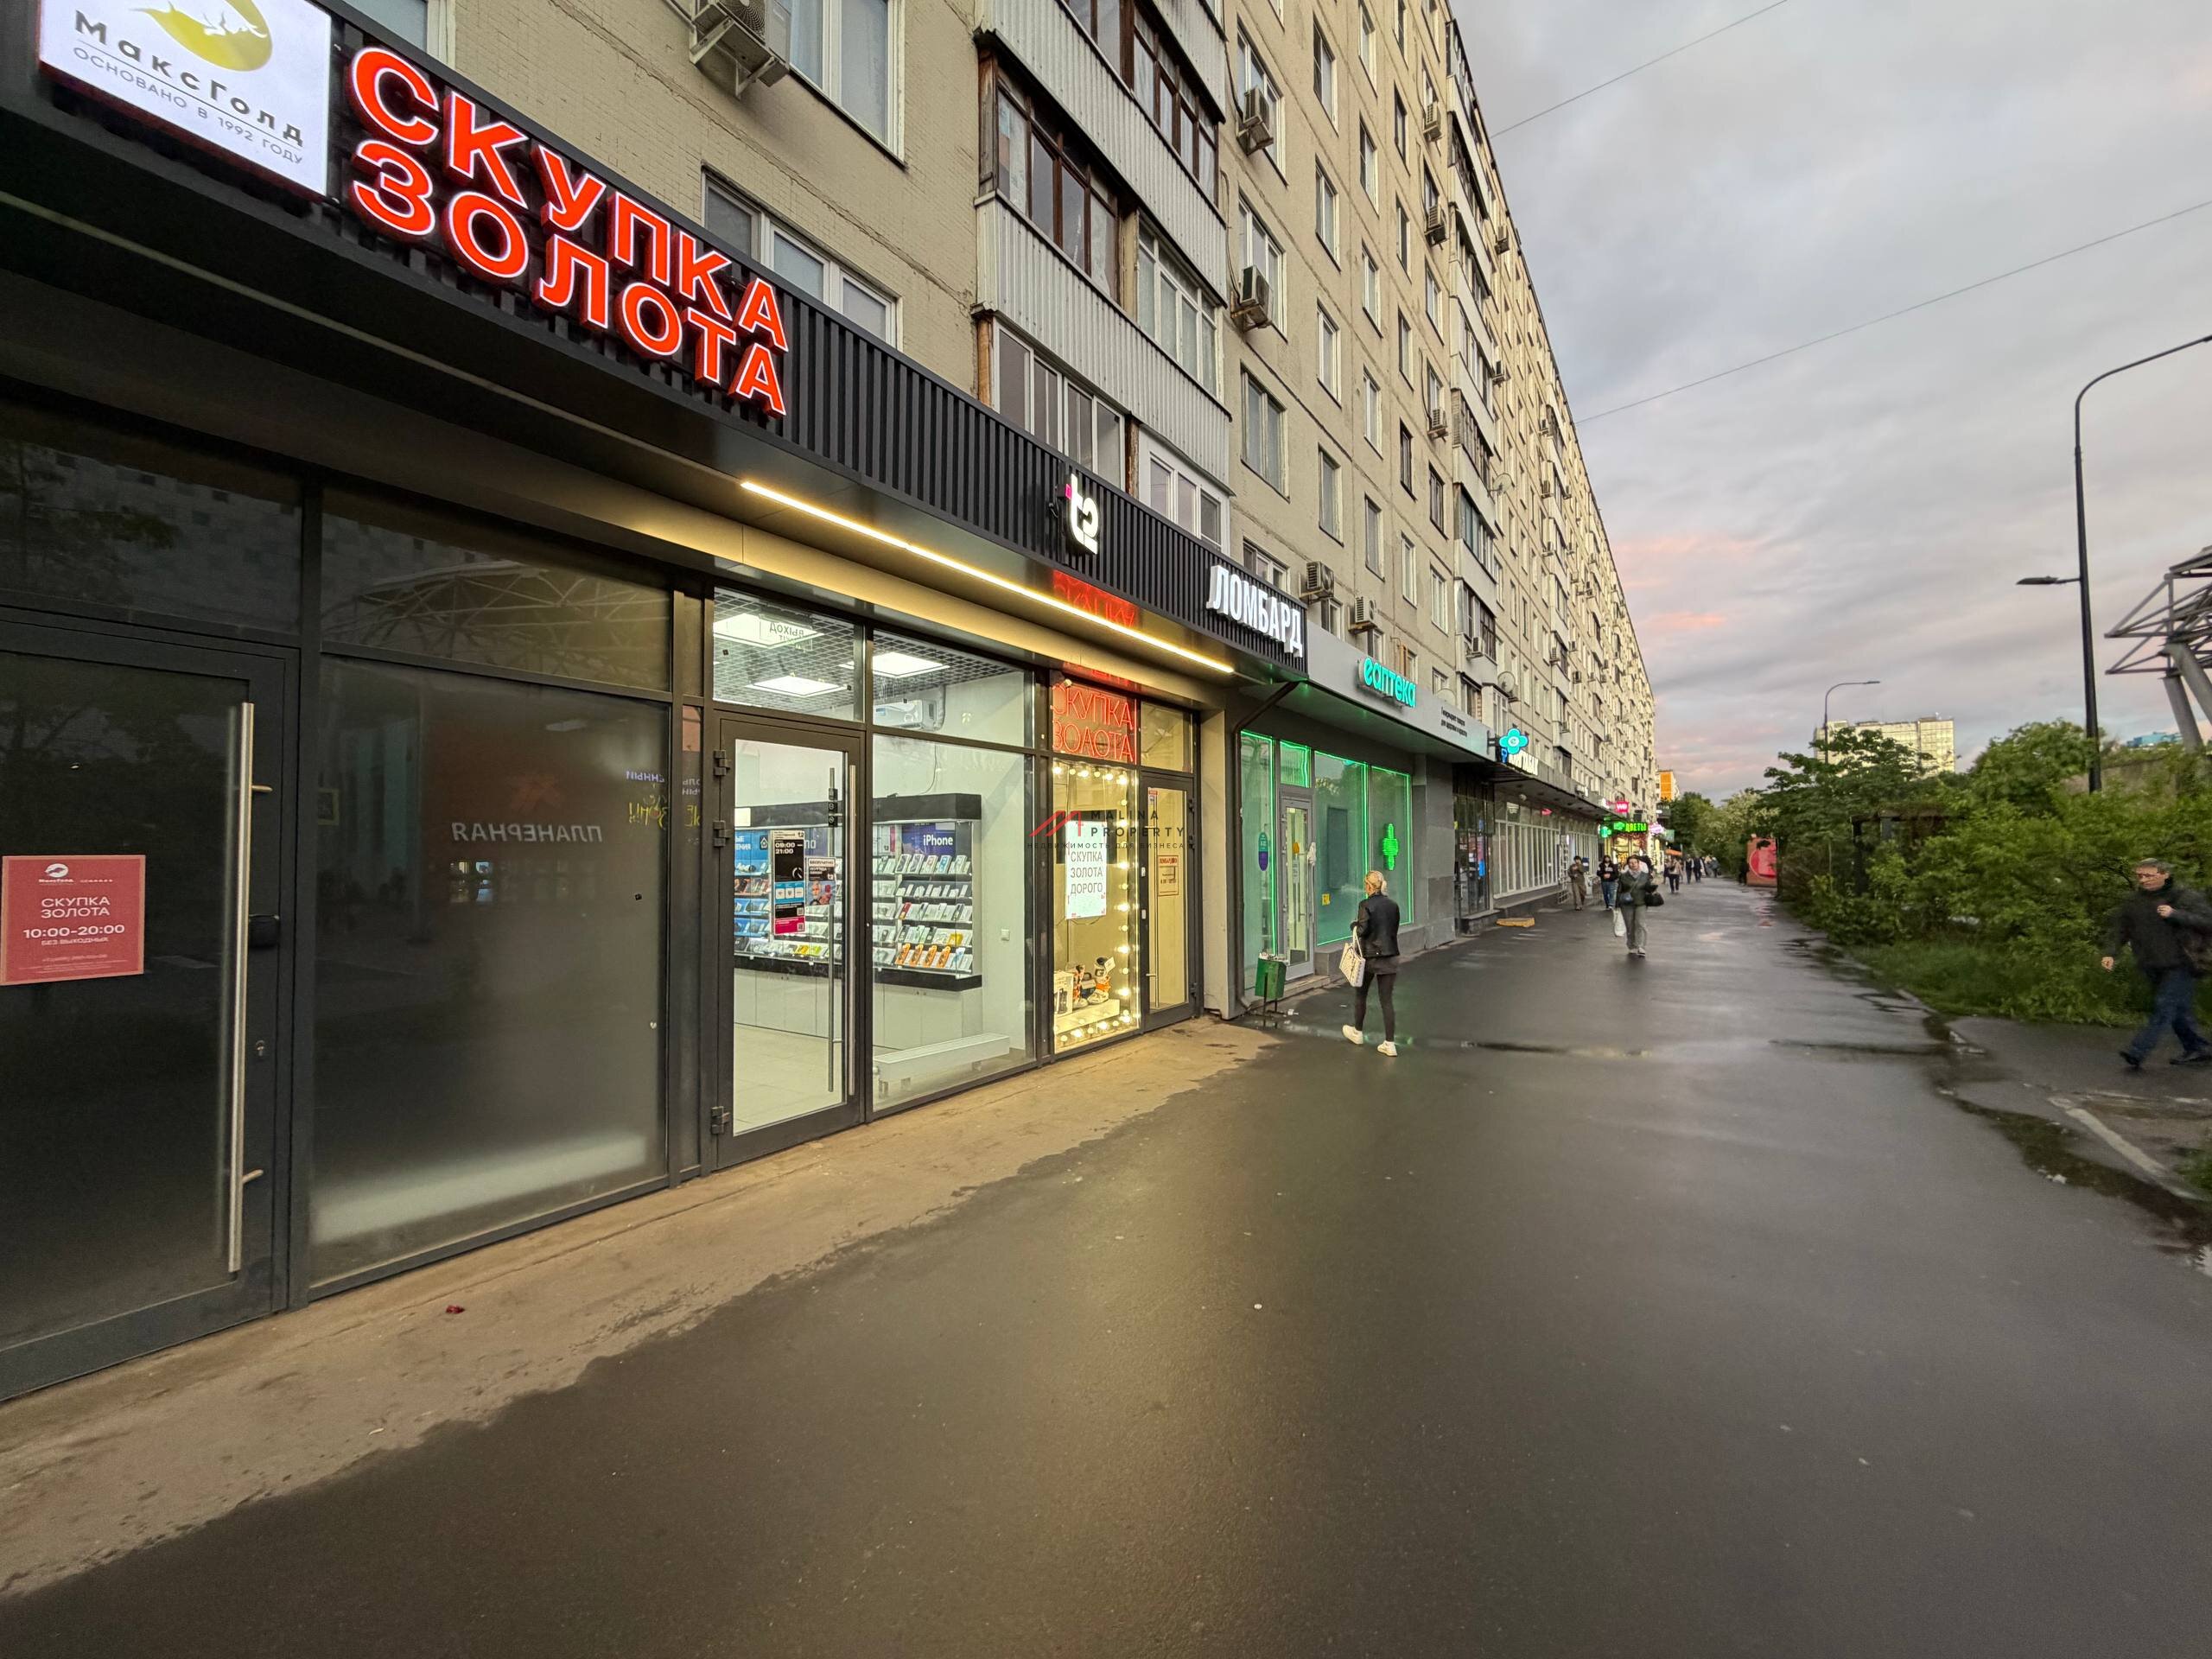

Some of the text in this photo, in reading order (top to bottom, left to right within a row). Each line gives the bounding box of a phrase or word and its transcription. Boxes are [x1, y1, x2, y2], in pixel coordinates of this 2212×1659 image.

[75, 10, 303, 147] МаксГолд
[73, 47, 302, 164] ОСНОВАНО В 1992 ГОДУ
[350, 46, 787, 352] СКУПКА
[350, 140, 787, 417] ЗОЛОТА
[1208, 564, 1303, 658] ЛОМБАРД
[1363, 655, 1417, 709] еаптека
[1052, 683, 1134, 731] СКУПКА
[1052, 718, 1134, 762] ЗОЛОТА
[923, 834, 954, 846] iPhone
[1625, 823, 1646, 832] ЦВЕТЫ
[1070, 850, 1103, 862] СКУПКА
[1070, 867, 1103, 878] ЗОЛОТА
[41, 896, 111, 908] СКУПКА
[1070, 882, 1103, 897] ДОРОГО
[41, 907, 111, 918] ЗОЛОТА
[23, 925, 125, 938] 10:00-20:00
